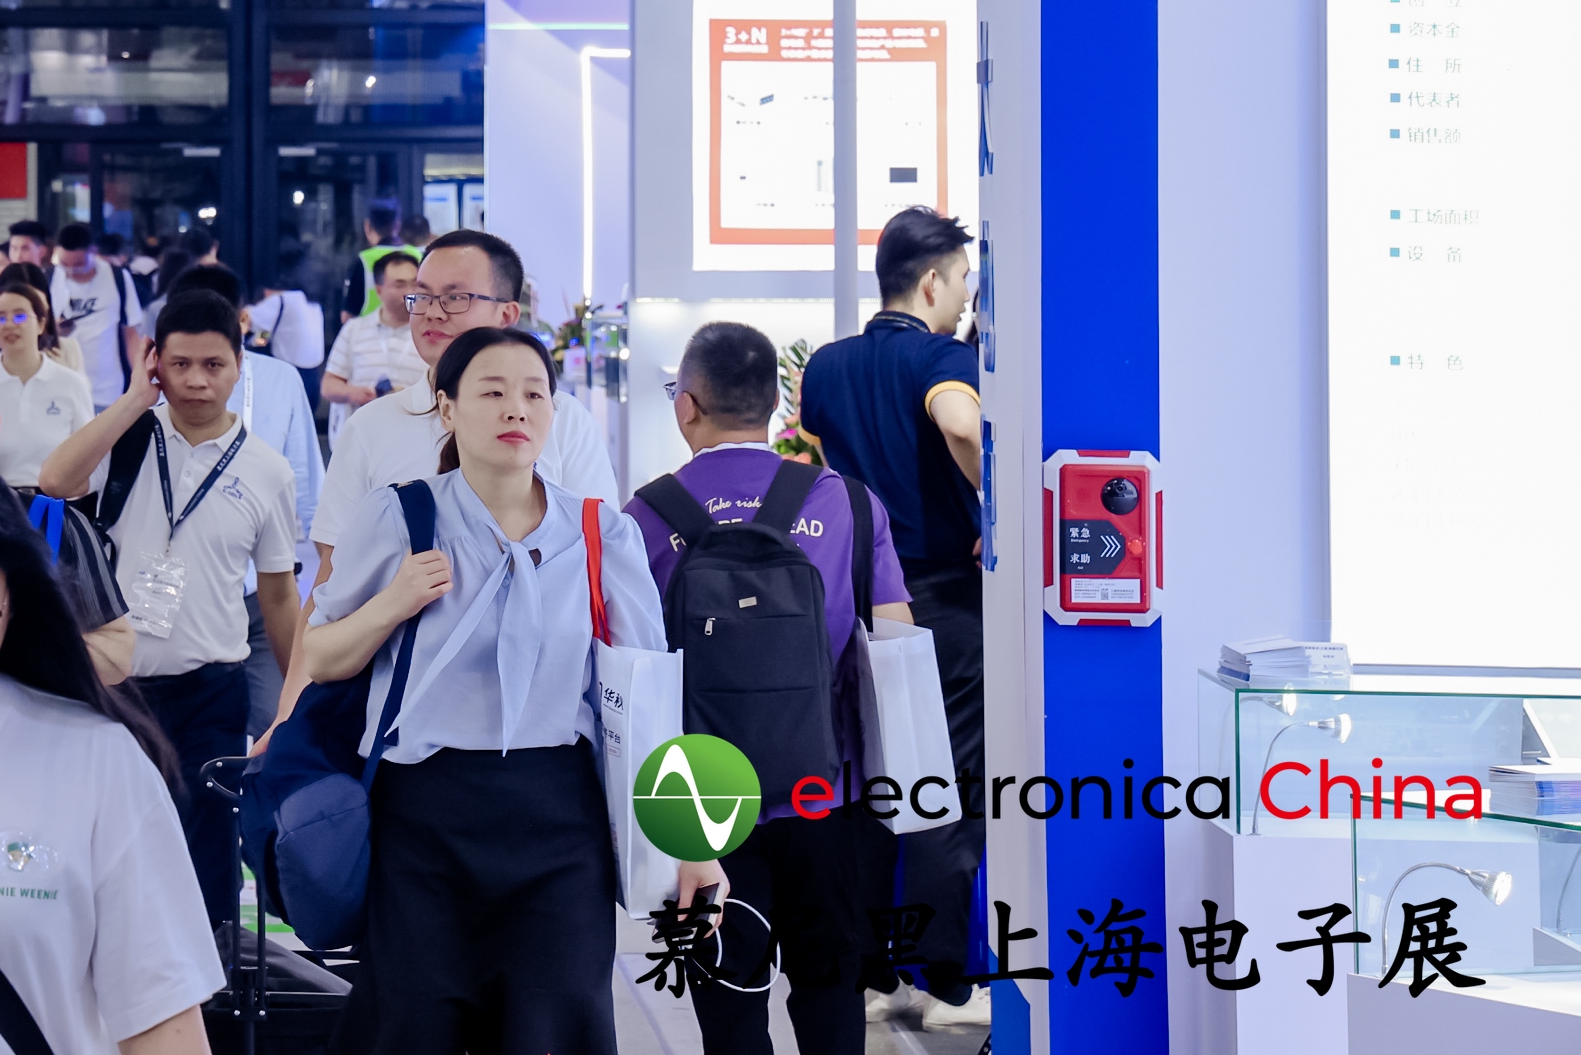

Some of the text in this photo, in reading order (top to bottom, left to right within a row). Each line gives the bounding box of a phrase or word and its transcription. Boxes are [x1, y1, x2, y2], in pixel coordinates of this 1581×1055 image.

[1408, 21, 1460, 38] 资本金
[1408, 91, 1461, 108] 代表者
[704, 496, 763, 514] Take risk
[1069, 553, 1091, 564] 求助
